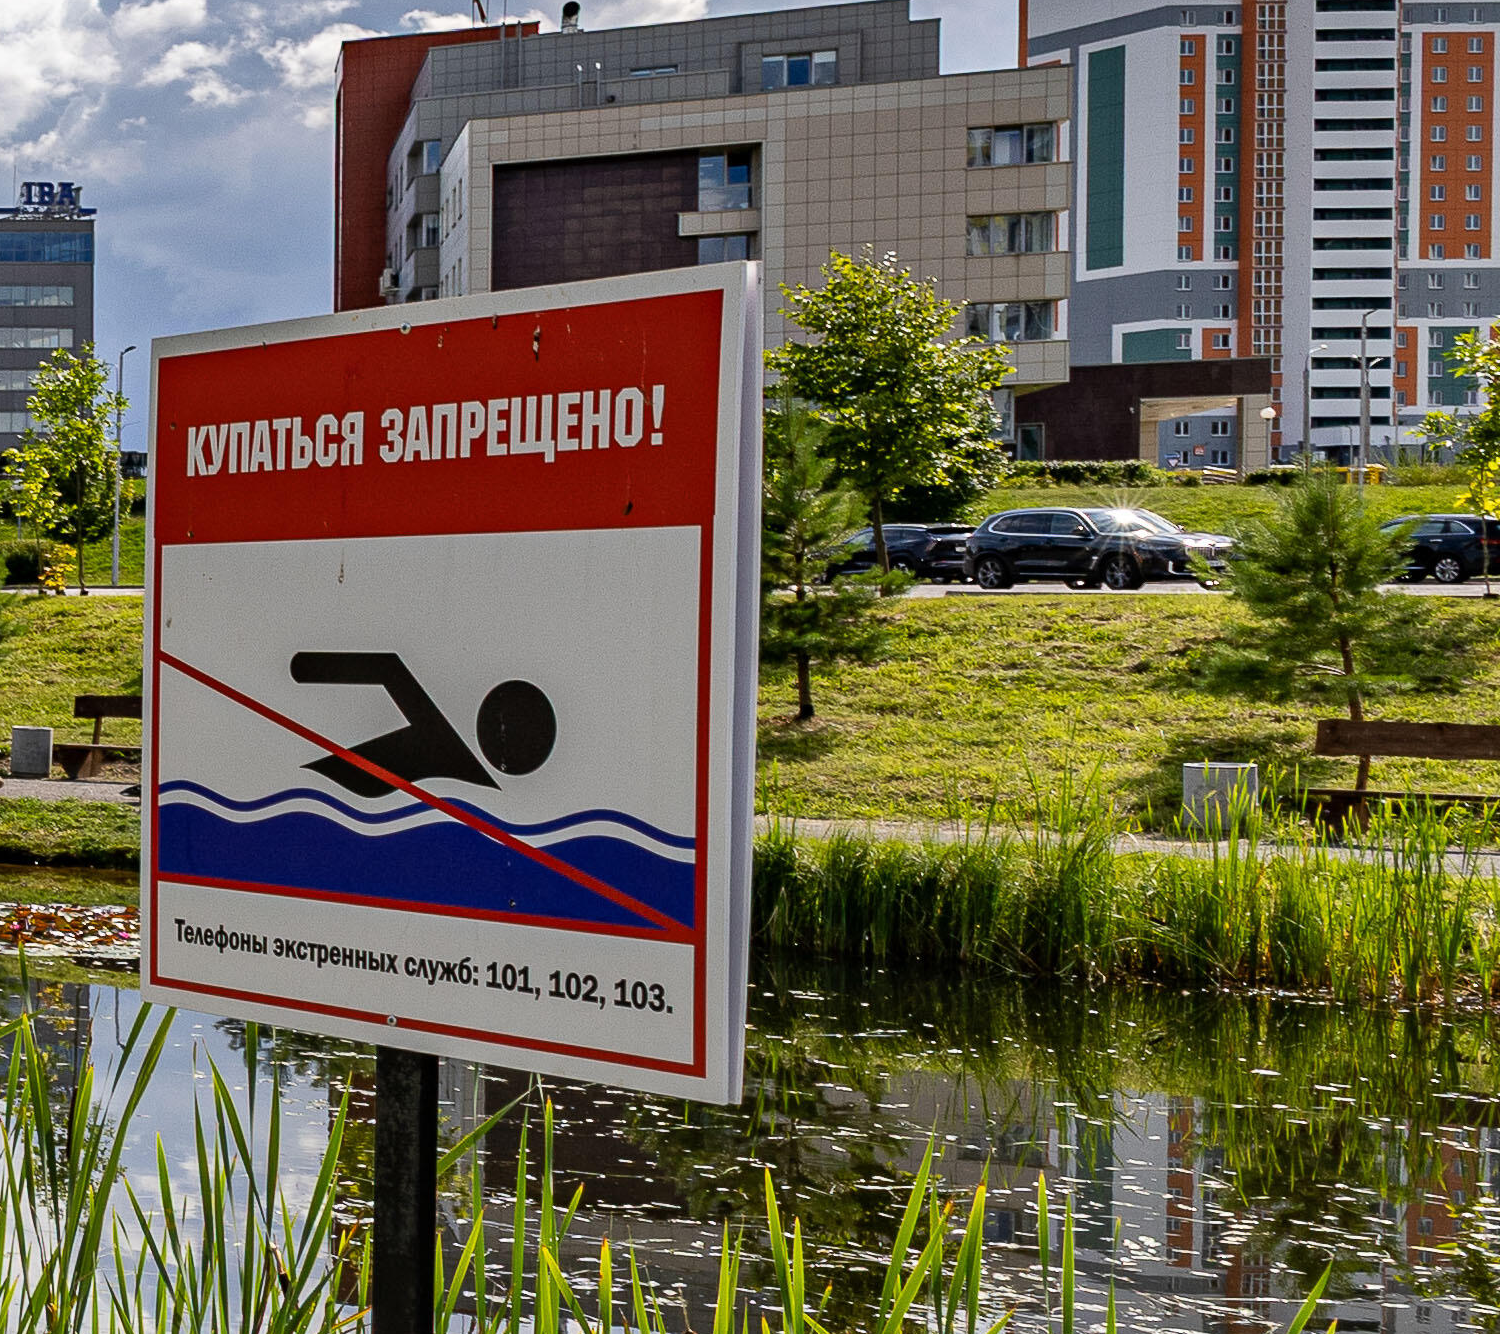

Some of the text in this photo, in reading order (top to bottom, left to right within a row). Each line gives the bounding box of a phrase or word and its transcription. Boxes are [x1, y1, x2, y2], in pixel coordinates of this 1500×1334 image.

[22, 182, 75, 205] IBA
[187, 384, 665, 477] КУПАТЬСЯ ЗАПРЕЩЕНО!
[174, 918, 673, 1014] Телефоны экстренных служб: 101, 102, 103.
